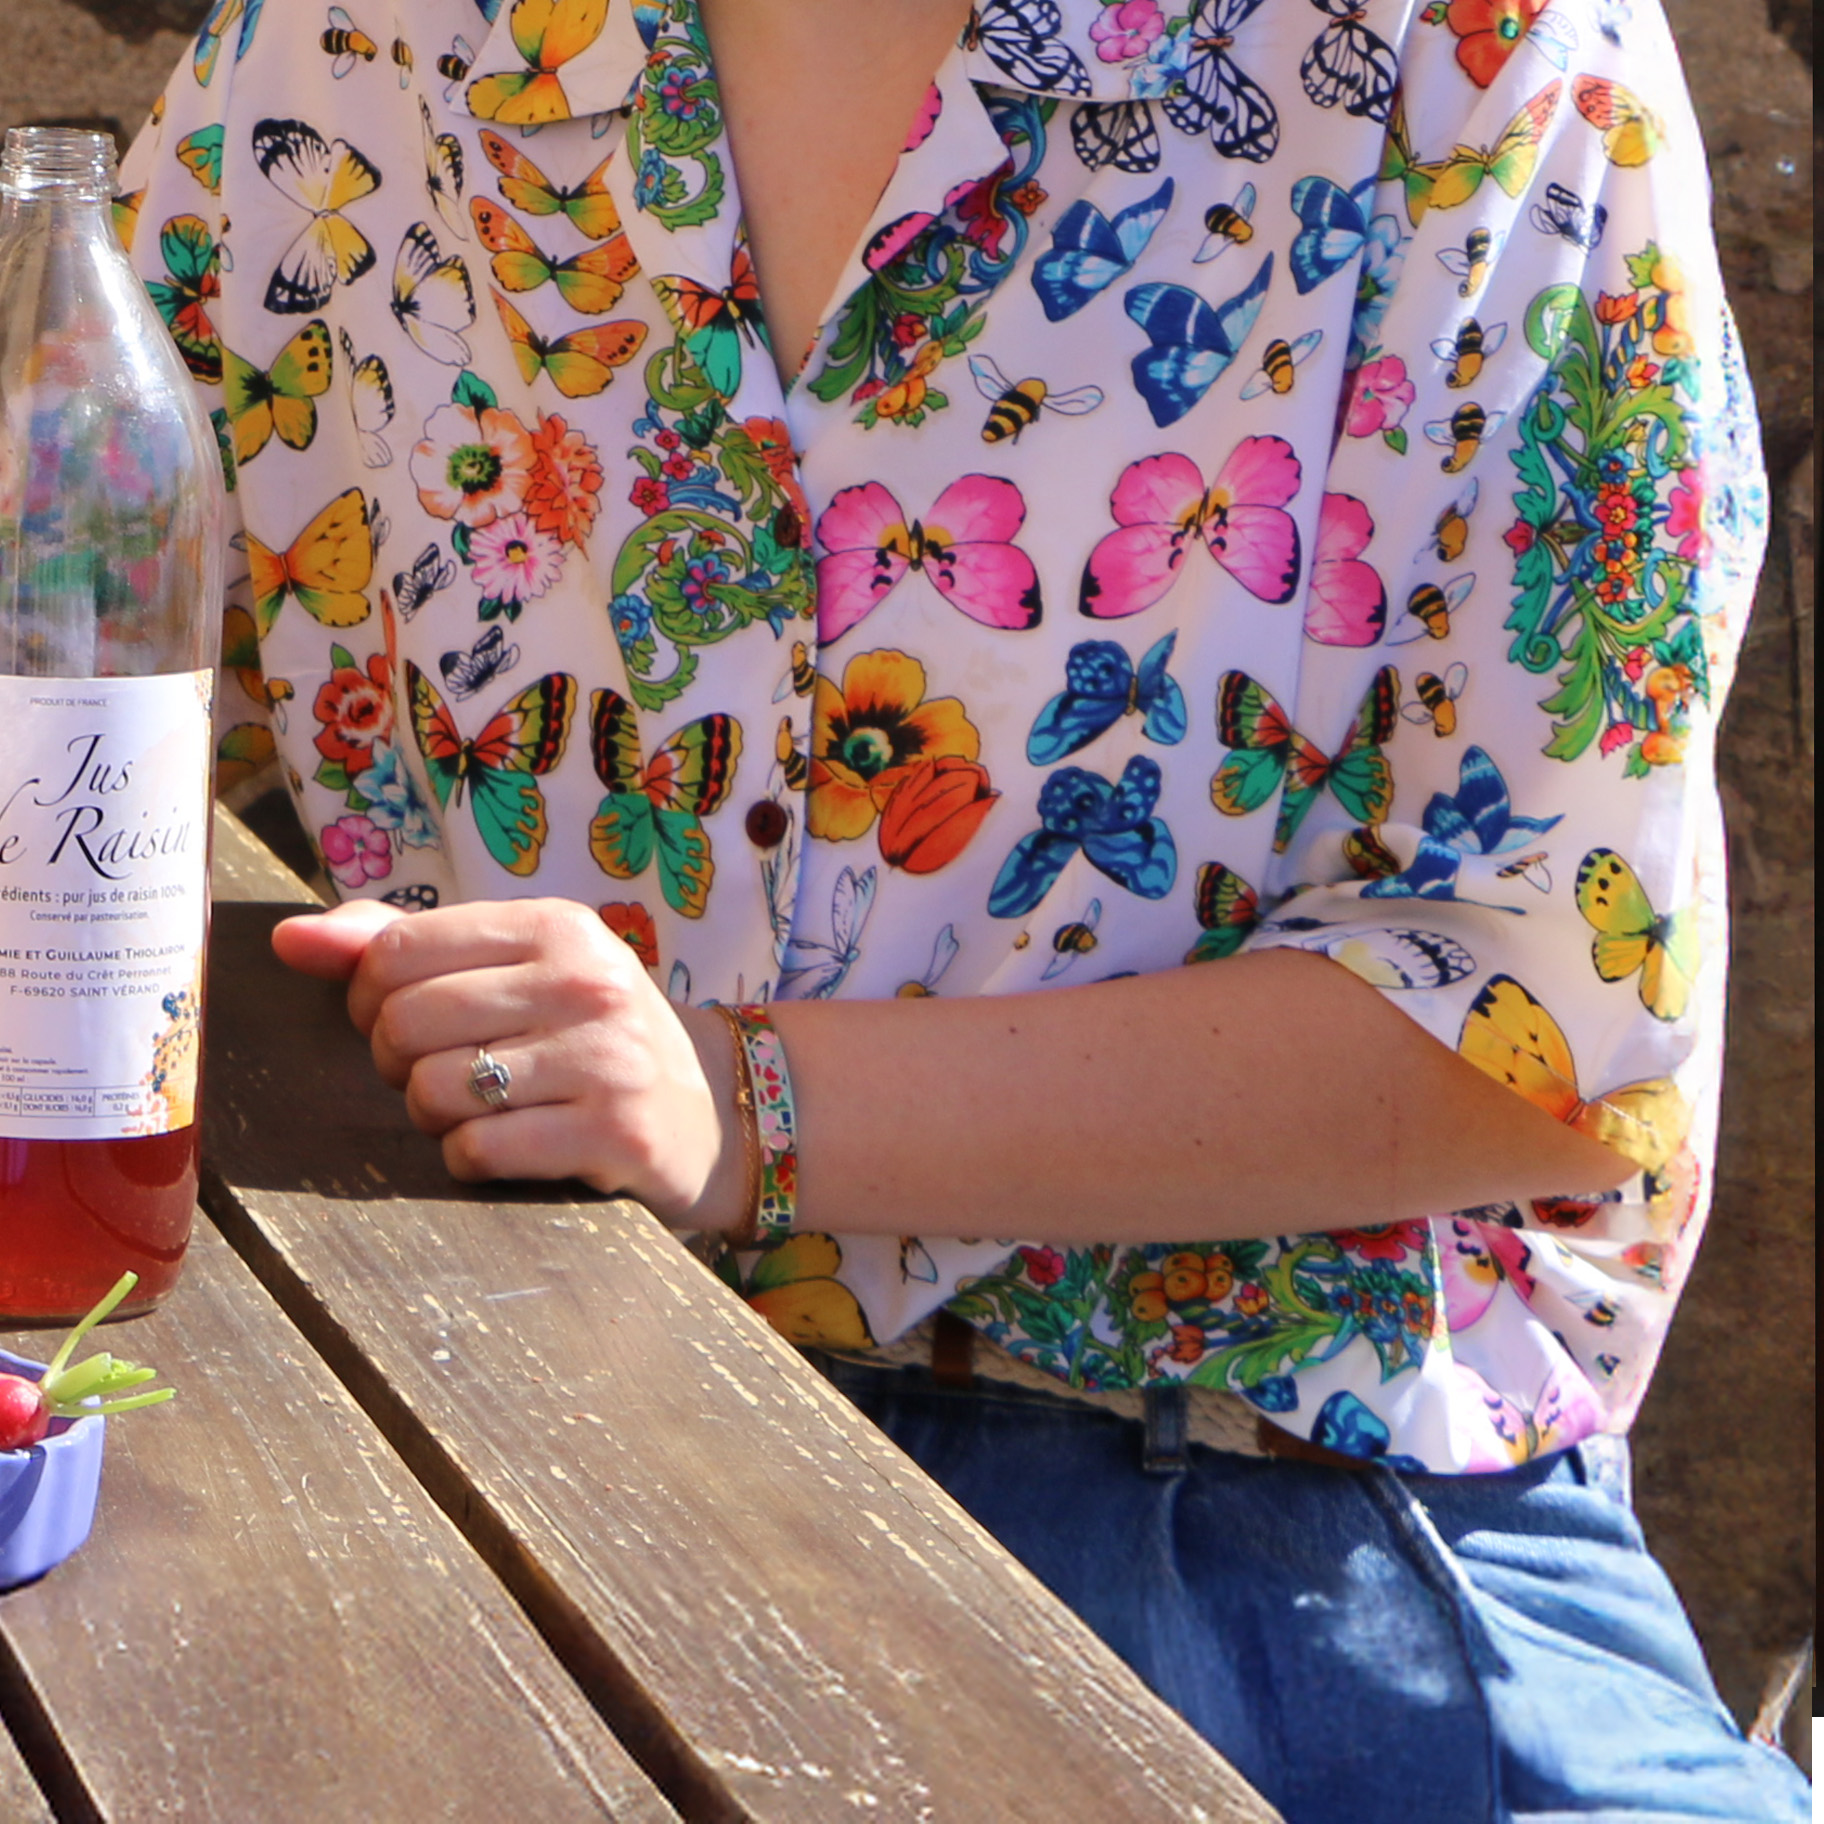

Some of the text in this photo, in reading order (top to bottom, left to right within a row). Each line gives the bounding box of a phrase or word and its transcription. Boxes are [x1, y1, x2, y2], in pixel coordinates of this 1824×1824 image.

[30, 697, 107, 707] PRODUIT DE FRANCE
[33, 733, 133, 806] Jus
[47, 805, 191, 880] Raisin
[63, 890, 84, 906] pur
[87, 888, 107, 907] jus
[110, 887, 124, 903] de
[127, 887, 158, 902] raisin
[160, 884, 186, 898] 100%
[29, 909, 72, 922] Conservé
[74, 912, 87, 924] par
[26, 950, 40, 960] ET
[45, 949, 121, 962] GUILLAUME
[21, 969, 61, 981] Route
[66, 970, 83, 981] du
[87, 968, 114, 981] Crêt
[10, 982, 160, 998] F-69620 SAINT VÉRAND
